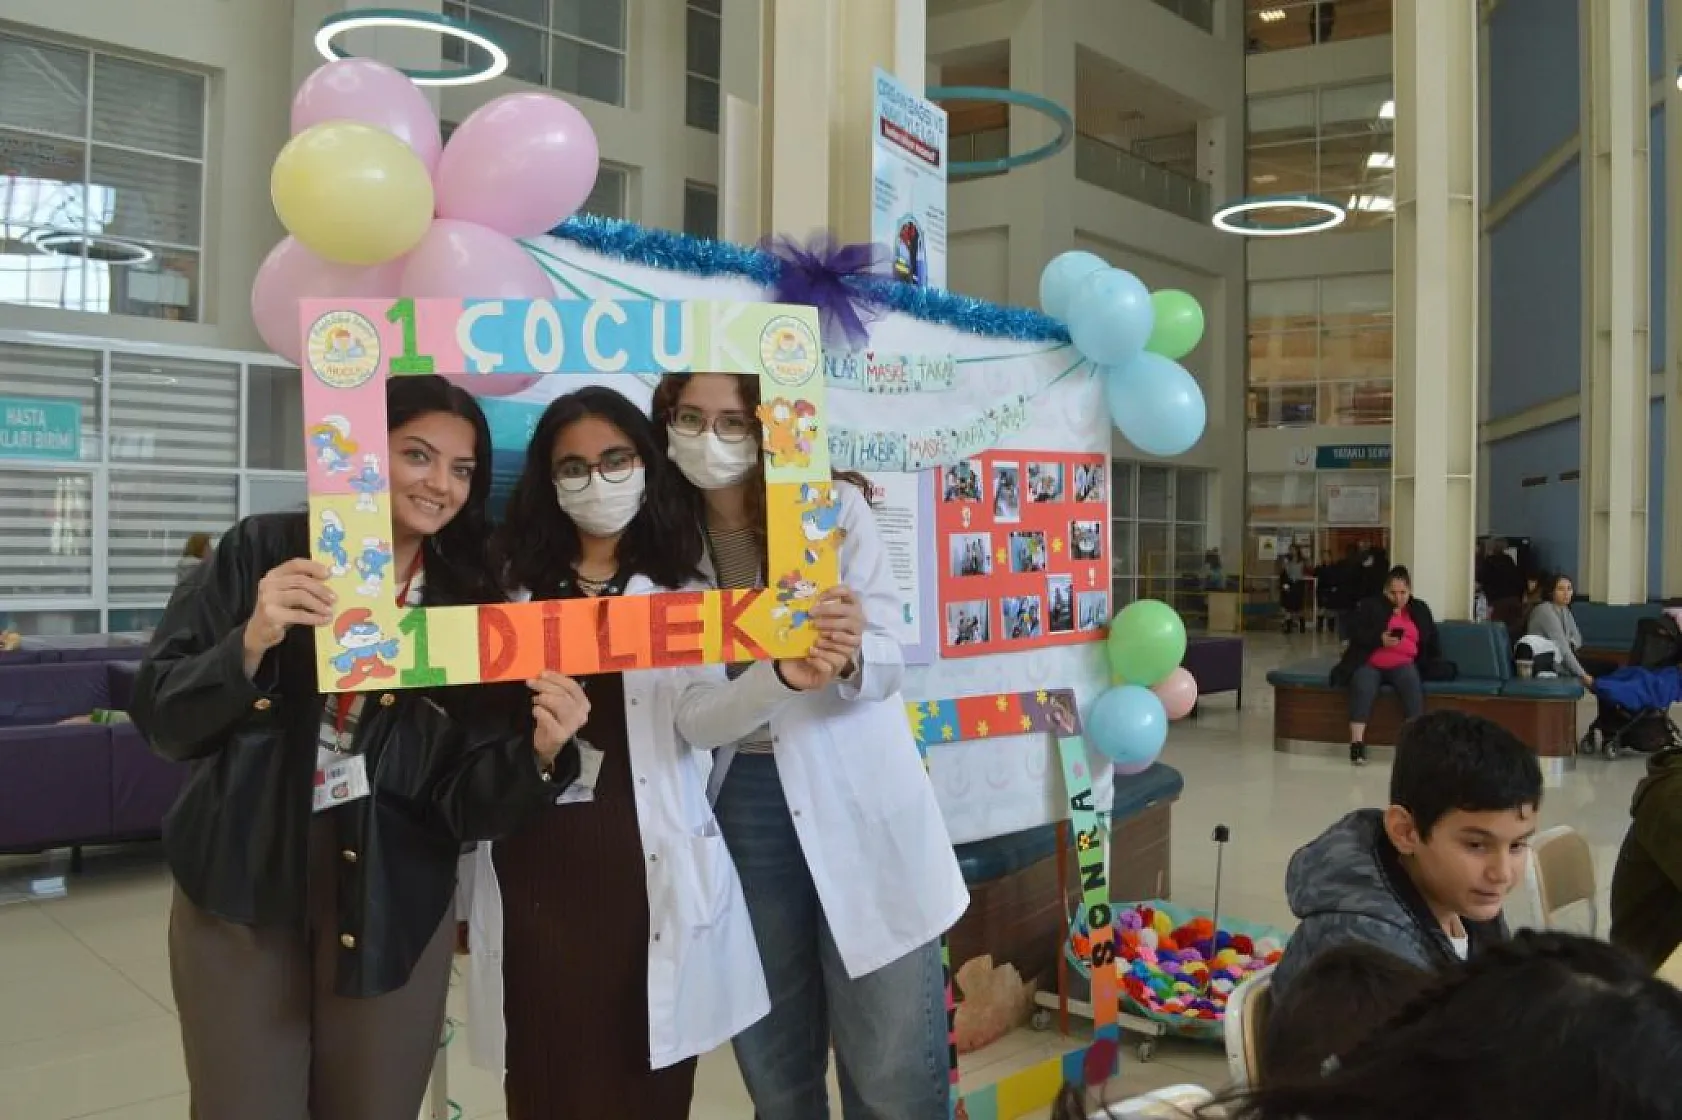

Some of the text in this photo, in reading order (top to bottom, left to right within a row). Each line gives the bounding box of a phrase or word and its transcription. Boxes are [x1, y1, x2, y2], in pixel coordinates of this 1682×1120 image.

[385, 297, 760, 375] 1 ÇOCUK
[6, 407, 47, 427] HASTA
[397, 587, 773, 686] 1 DİLEK
[1070, 787, 1118, 969] SONRA
